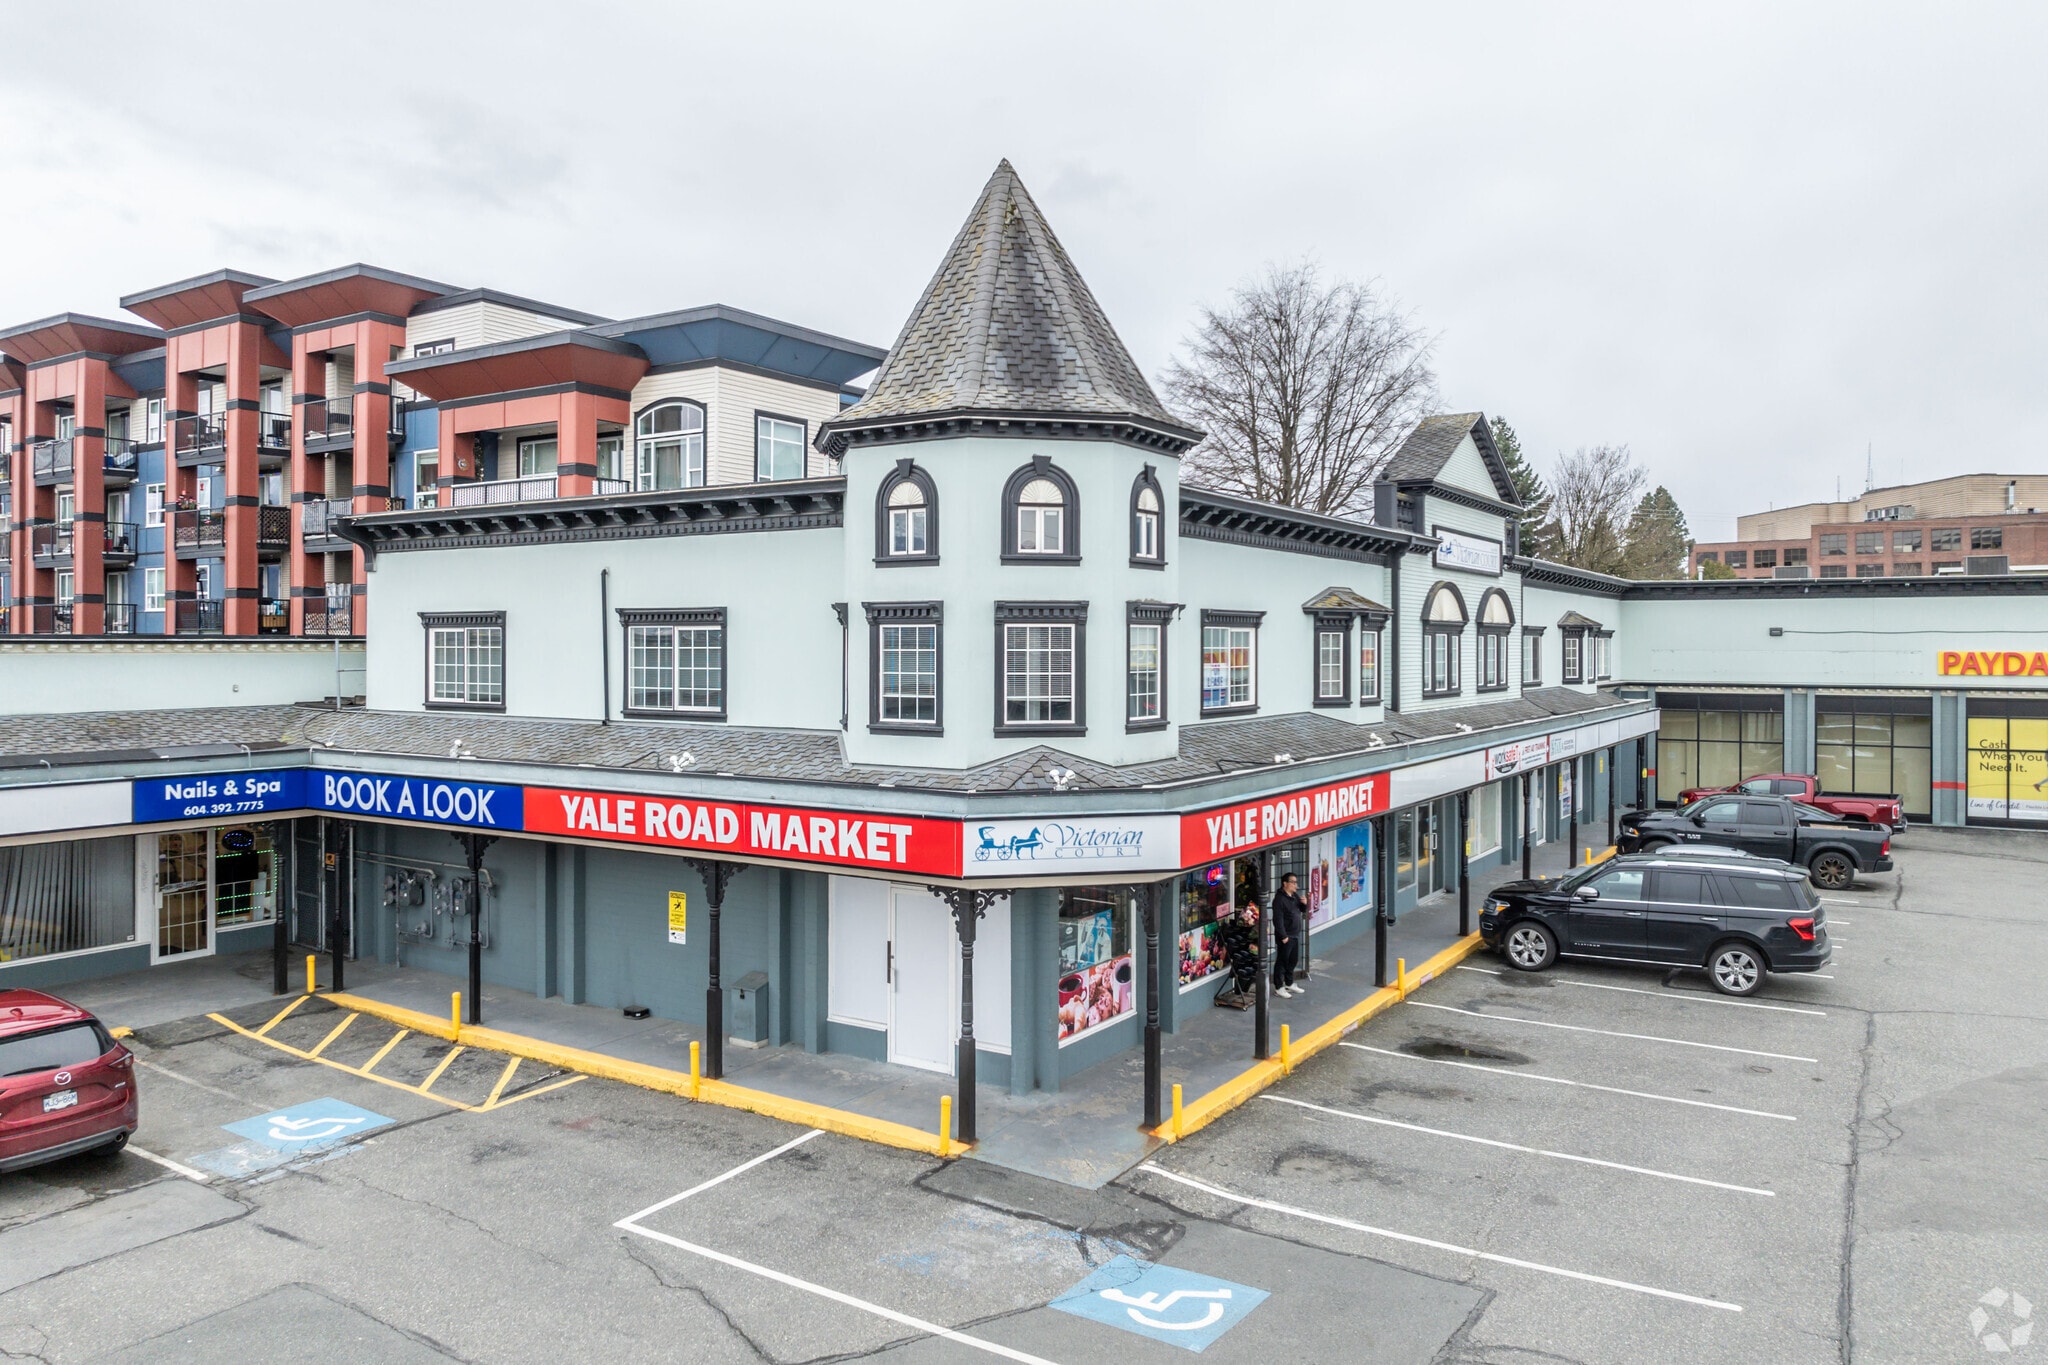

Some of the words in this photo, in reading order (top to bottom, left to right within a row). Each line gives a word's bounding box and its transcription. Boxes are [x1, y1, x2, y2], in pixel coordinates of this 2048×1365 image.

[1979, 739, 2008, 750] Cash
[1979, 751, 2016, 761] When
[2019, 752, 2043, 762] You
[1979, 762, 2011, 772] Need
[2016, 763, 2027, 773] It.
[165, 781, 217, 800] Nails
[223, 779, 239, 796] &
[245, 778, 281, 798] Spa
[325, 775, 392, 813] BOOK
[396, 779, 417, 815] A
[423, 783, 496, 825] LOOK
[1969, 800, 1984, 808] Line
[1986, 800, 1994, 811] of
[1995, 800, 2020, 810] Credit
[1206, 808, 1258, 854] YALE
[1261, 796, 1311, 841] ROAD
[1314, 780, 1374, 826] MARKET
[560, 795, 636, 835] YALE
[644, 801, 739, 844] ROAD
[750, 811, 912, 863] MARKET
[1043, 823, 1144, 848] Victorian
[1055, 847, 1142, 859] COURT
